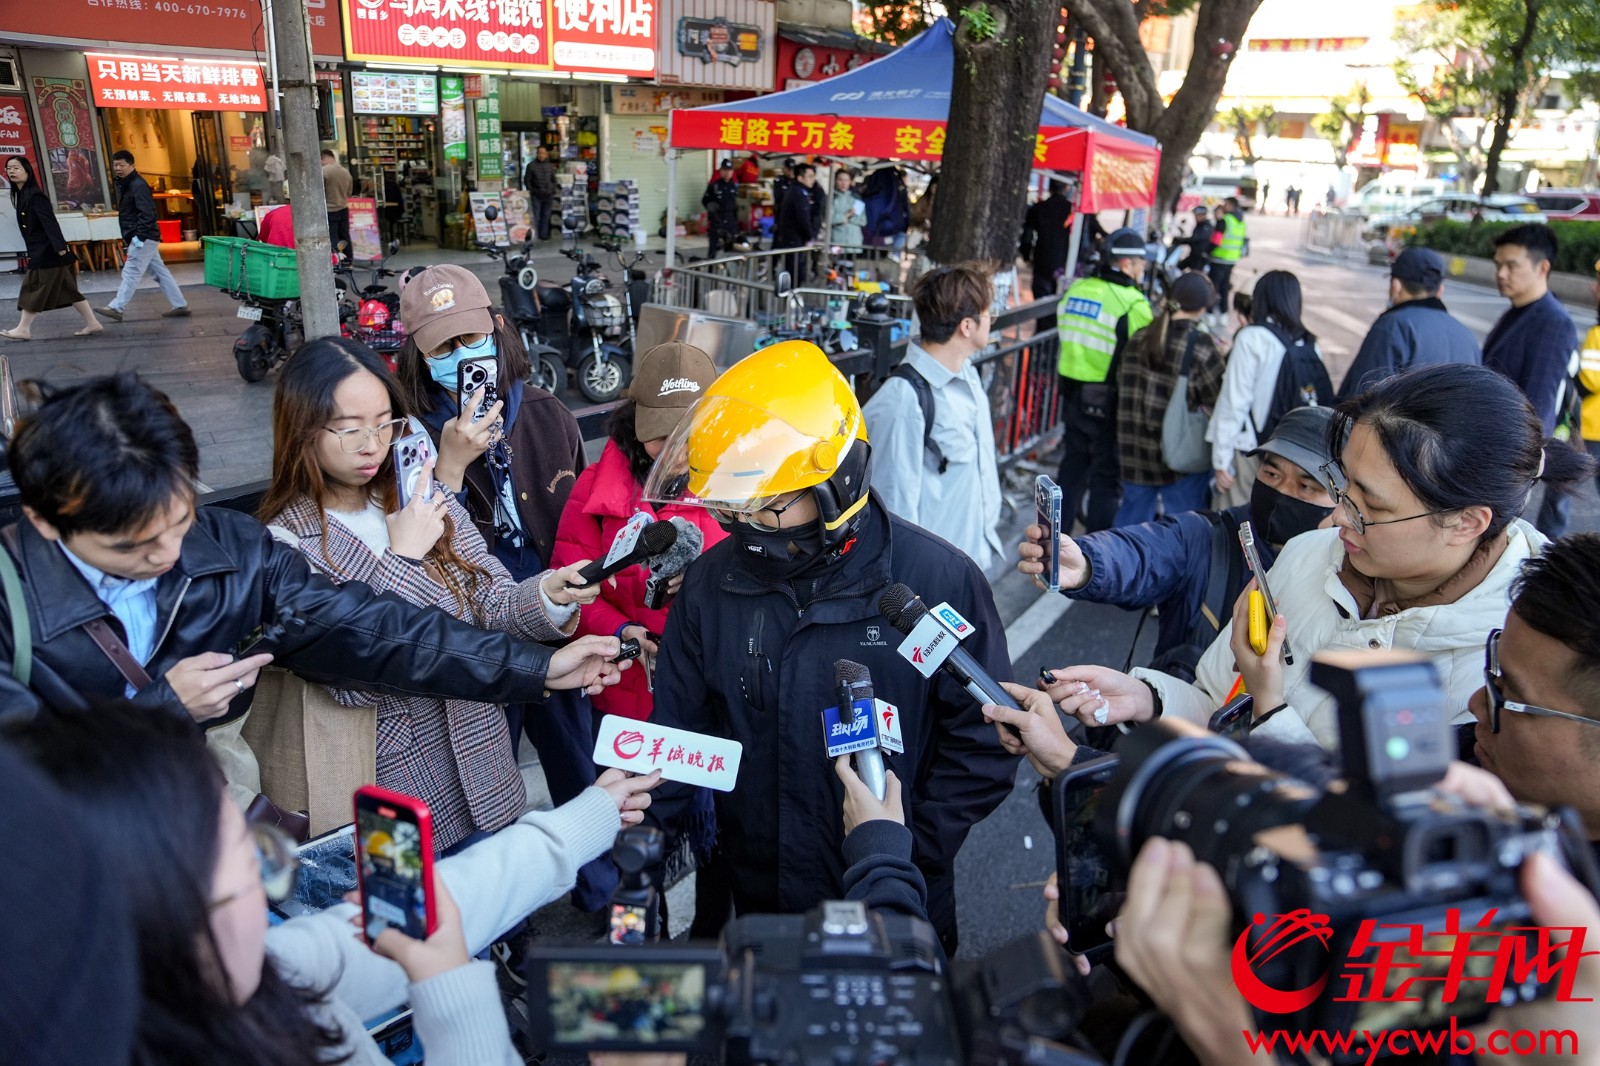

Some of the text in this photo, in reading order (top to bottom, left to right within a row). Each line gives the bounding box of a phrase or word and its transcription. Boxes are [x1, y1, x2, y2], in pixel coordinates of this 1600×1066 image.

[154, 1, 247, 19] 400-670-7976
[554, 0, 653, 37] 便利店
[97, 60, 259, 87] 只用当天新鲜排骨
[719, 117, 855, 151] 道路千万条
[660, 377, 700, 393] Nothing
[647, 738, 725, 773] 羊城晚报
